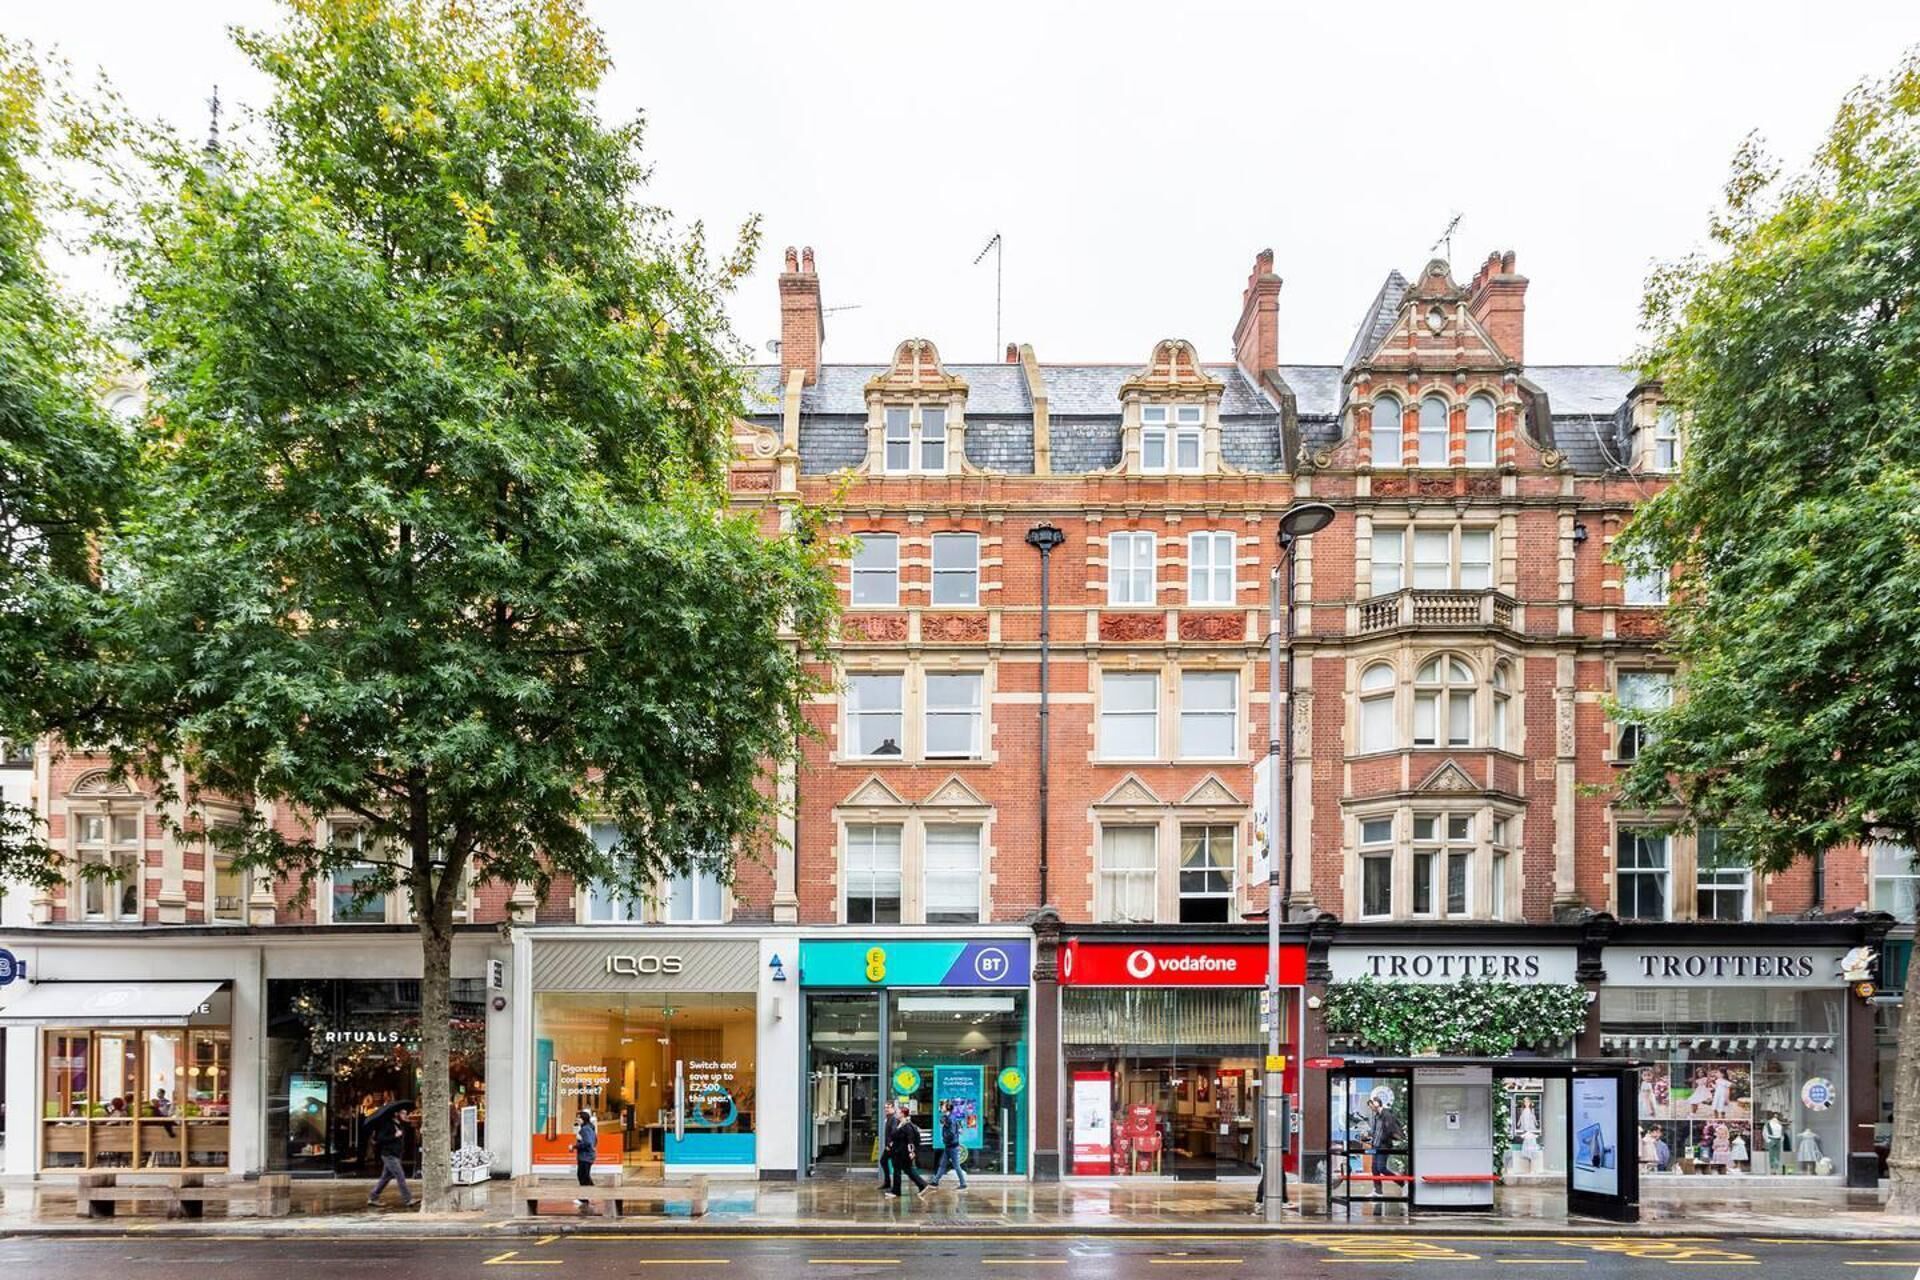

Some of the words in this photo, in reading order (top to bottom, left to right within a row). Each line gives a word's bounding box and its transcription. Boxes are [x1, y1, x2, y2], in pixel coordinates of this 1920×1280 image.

[606, 955, 683, 976] IQOS
[982, 958, 1002, 971] BT
[1158, 955, 1237, 972] vodafone
[1367, 955, 1540, 977] TROTTERS
[1640, 955, 1814, 977] TROTTERS
[560, 1064, 607, 1074] Cigarettes
[689, 1061, 719, 1069] Switch
[720, 1061, 737, 1069] and
[594, 1077, 610, 1086] you
[689, 1073, 709, 1081] save
[710, 1073, 722, 1083] up
[723, 1072, 734, 1081] to
[567, 1086, 603, 1096] pocket?
[689, 1094, 706, 1102] this
